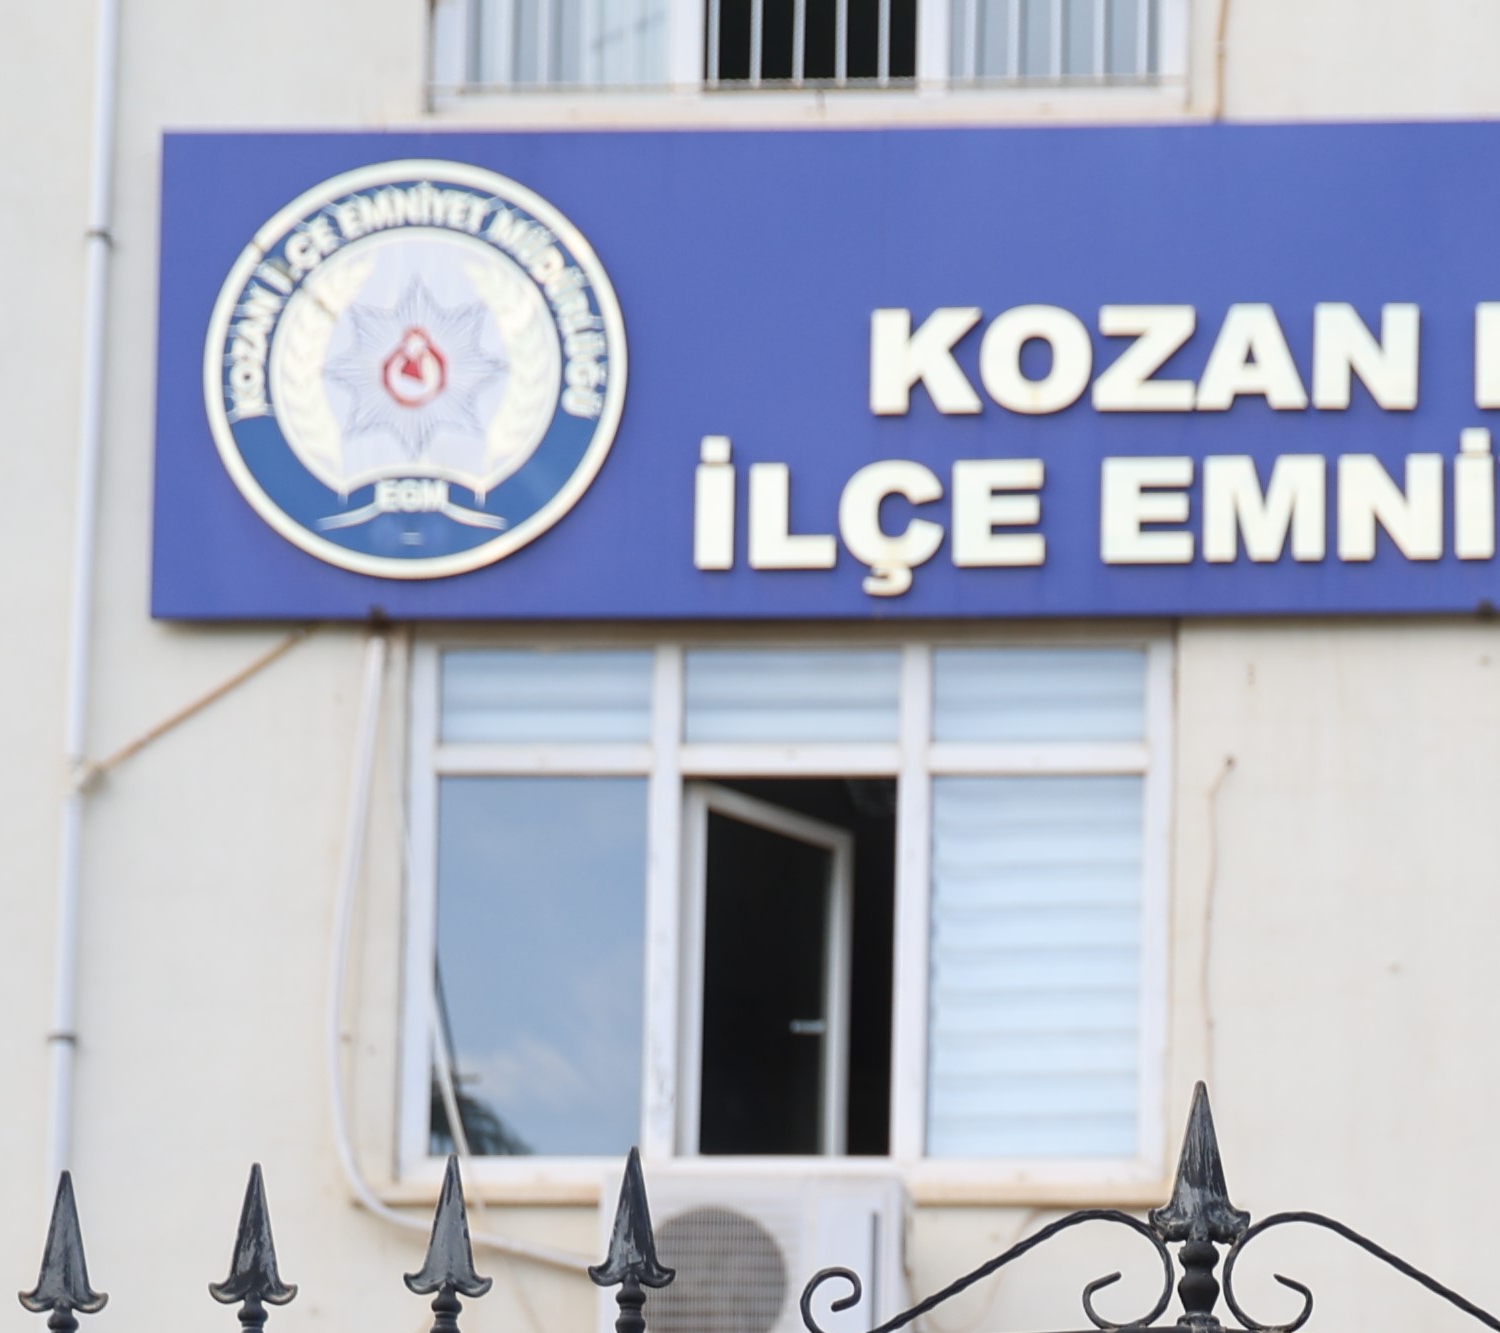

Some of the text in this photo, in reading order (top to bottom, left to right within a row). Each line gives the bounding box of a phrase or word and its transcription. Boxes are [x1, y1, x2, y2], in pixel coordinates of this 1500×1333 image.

[229, 281, 276, 421] KOZAN
[331, 181, 490, 240] EMNİYET
[870, 302, 1421, 415] KOZAN
[374, 479, 450, 511] EGM
[693, 435, 1046, 597] İLÇE
